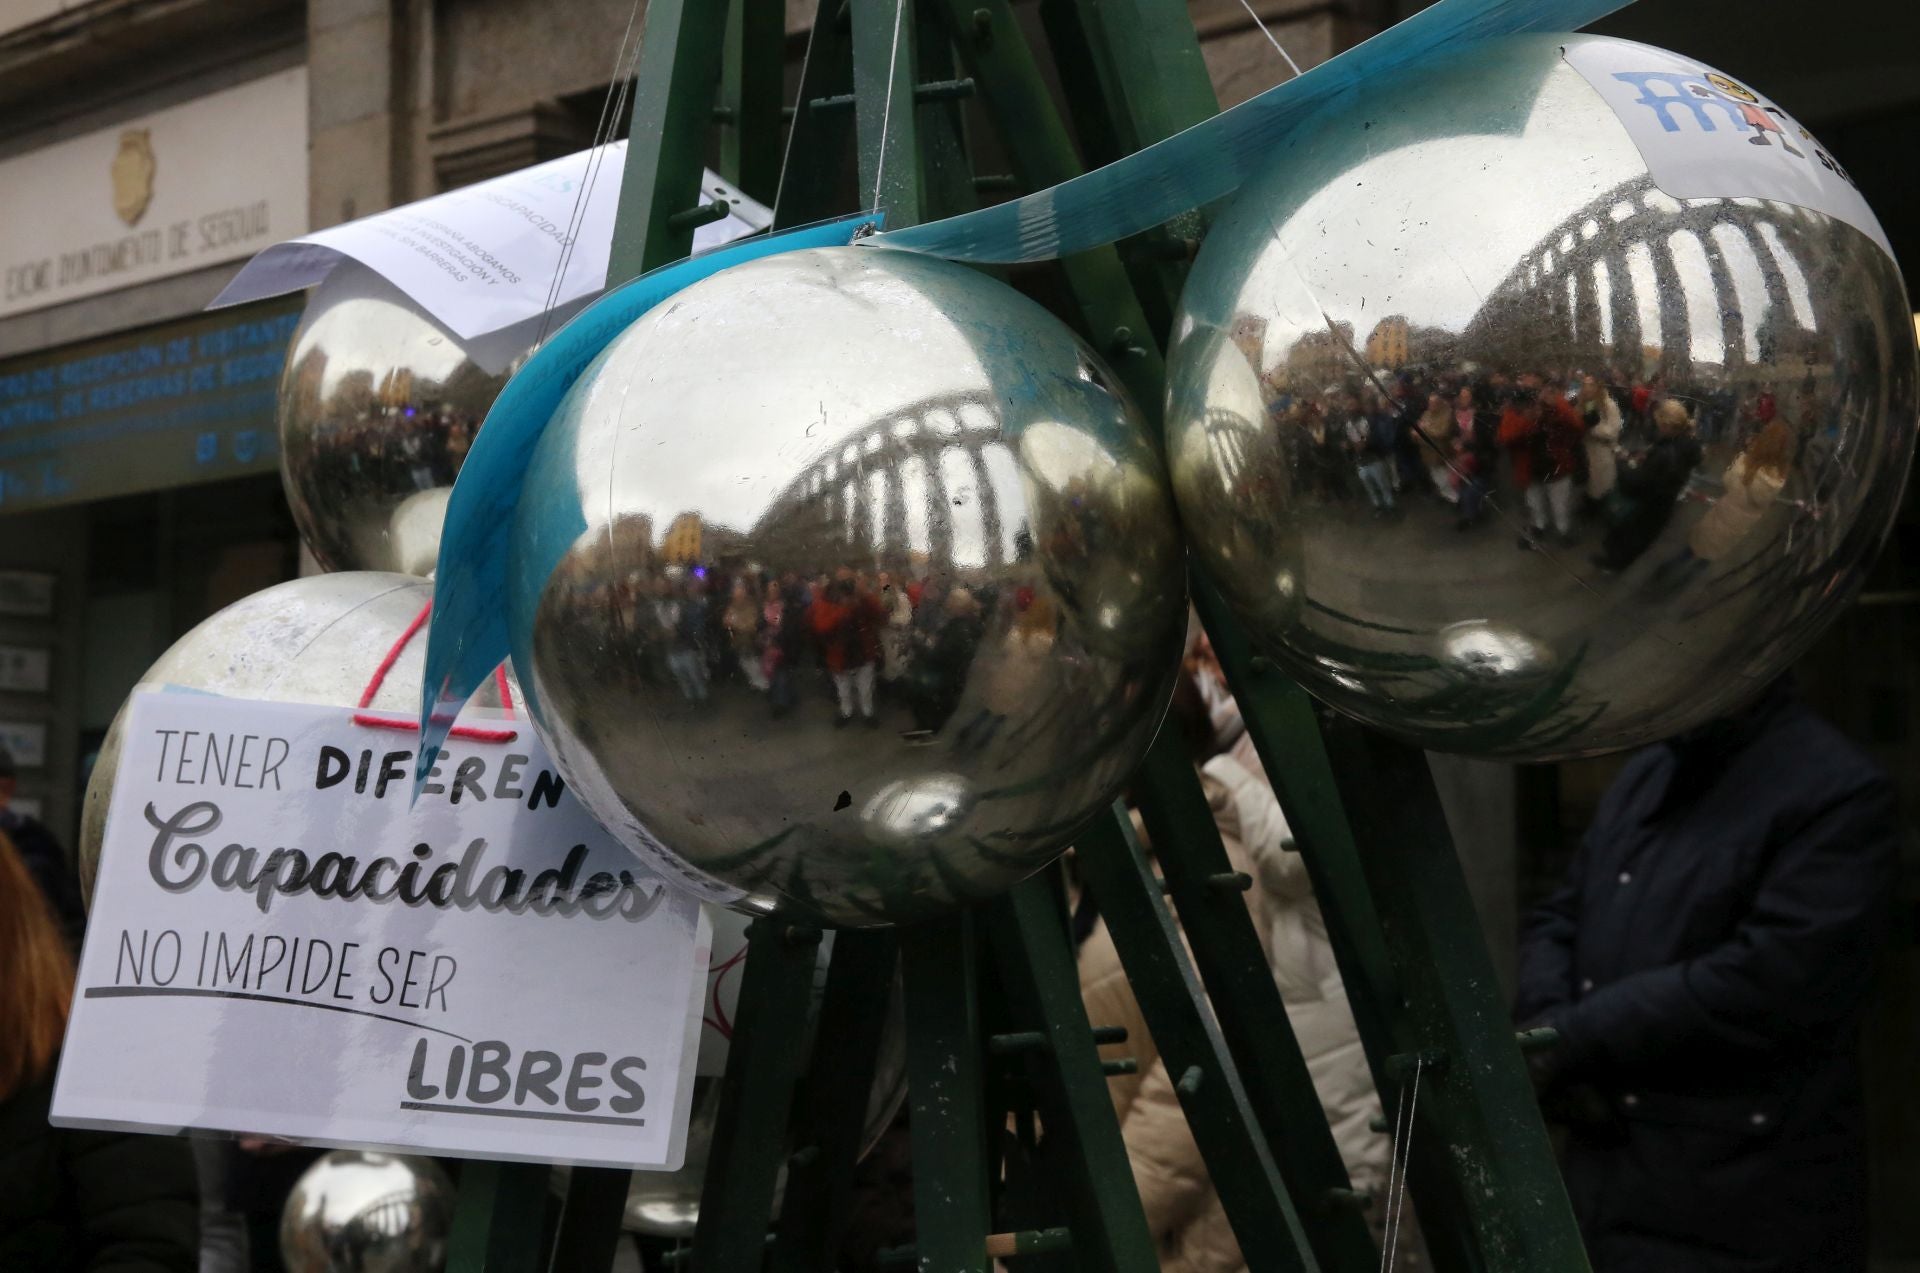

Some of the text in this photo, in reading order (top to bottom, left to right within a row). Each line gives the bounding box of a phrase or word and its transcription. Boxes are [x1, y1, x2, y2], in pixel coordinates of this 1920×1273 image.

[168, 220, 191, 258] DE
[415, 243, 469, 283] BARRERAS
[462, 241, 522, 285] ABOGAMOS
[154, 729, 290, 792] TENER
[314, 744, 565, 810] DIFEREN
[144, 800, 666, 921] Capacidades
[115, 929, 457, 1012] NO IMPIDE SER
[405, 1037, 647, 1114] LIBRES
